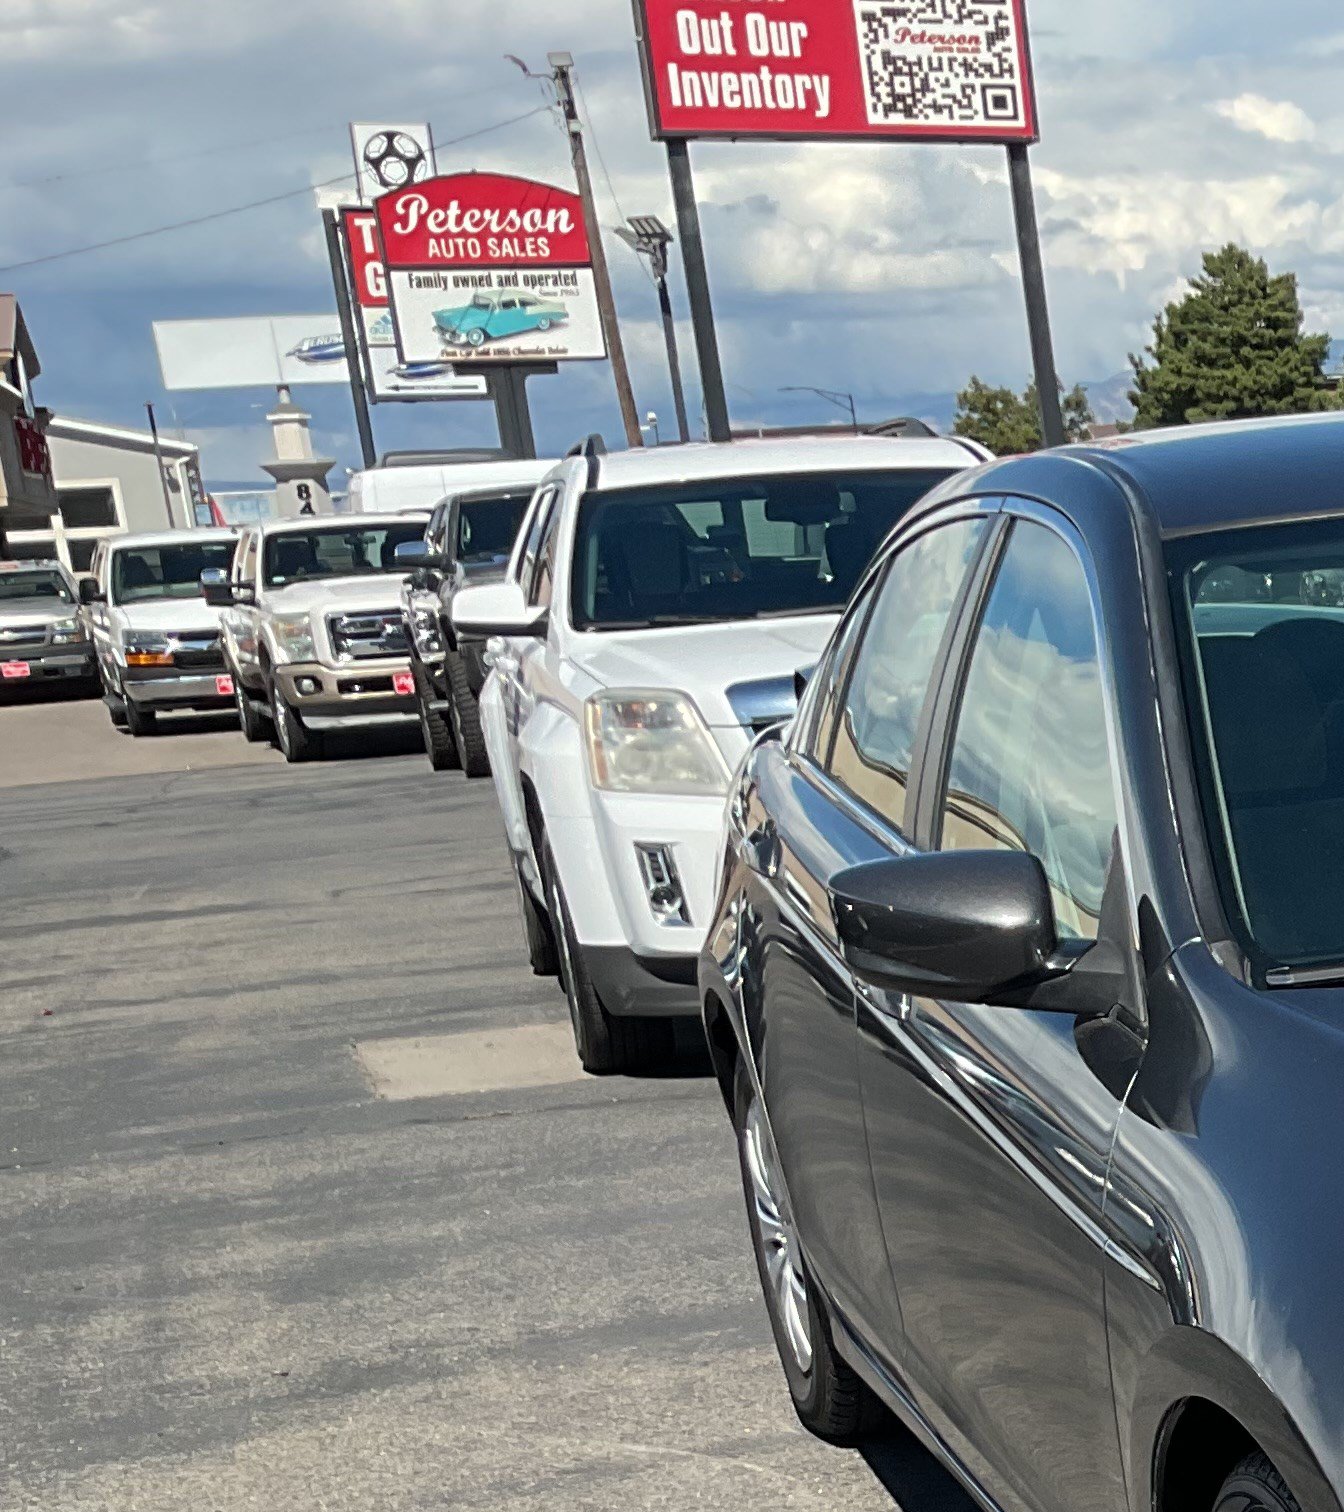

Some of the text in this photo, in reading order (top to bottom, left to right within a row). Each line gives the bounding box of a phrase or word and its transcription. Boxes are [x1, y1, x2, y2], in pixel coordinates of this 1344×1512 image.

[676, 9, 808, 58] Out Our
[893, 27, 981, 44] Peterson
[667, 62, 830, 118] Inventory
[393, 193, 575, 235] Peterson
[428, 236, 550, 258] AUTO SALES
[408, 270, 578, 291] Family owned and operated
